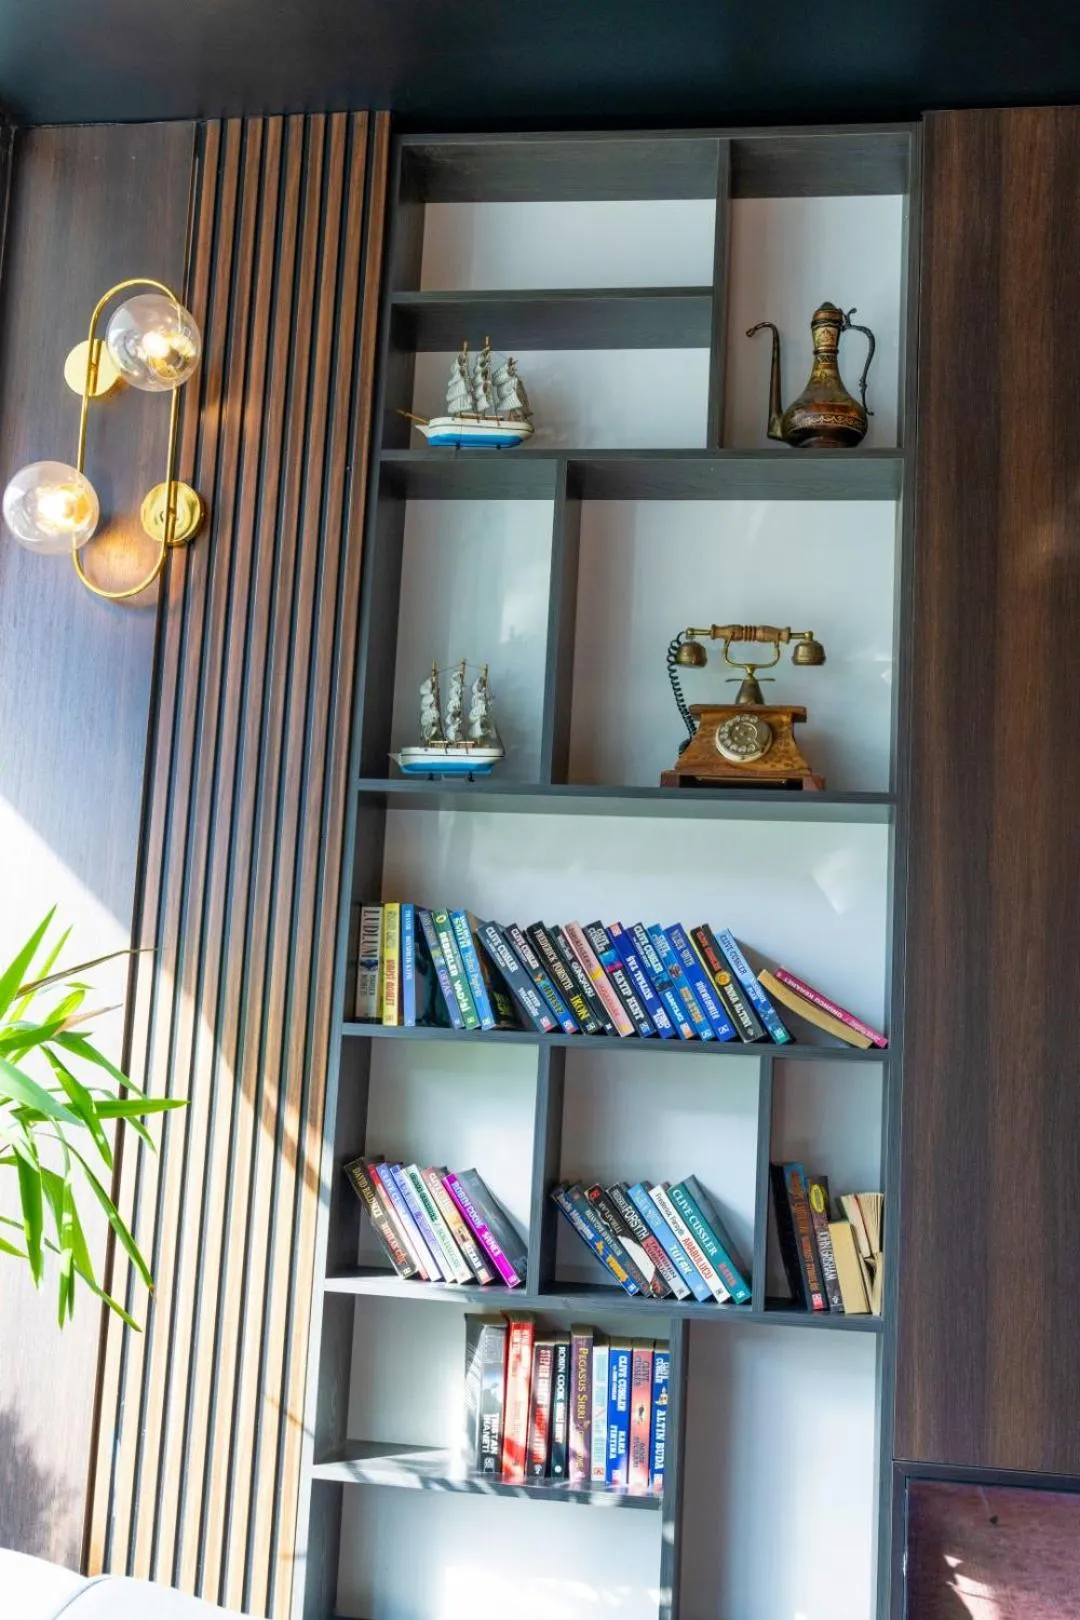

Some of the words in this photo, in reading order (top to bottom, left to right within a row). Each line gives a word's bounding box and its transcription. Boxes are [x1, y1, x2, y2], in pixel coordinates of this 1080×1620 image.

[360, 909, 379, 958] LUDLUM
[484, 925, 502, 946] CLIVE
[496, 943, 519, 973] CUSSLER
[510, 927, 525, 946] CLIVE
[519, 943, 539, 969] CUSSLER
[586, 926, 606, 953] CUSSLER
[594, 927, 609, 946] CLIVE
[632, 924, 649, 946] CLIVE
[642, 943, 663, 974] CUSSLER
[438, 931, 458, 976] BEBEKLER
[533, 928, 558, 963] FREDERICK
[551, 960, 573, 991] FORSYTH
[719, 934, 733, 952] CLIVE
[728, 949, 747, 975] CUSSLER
[612, 969, 632, 997] KAYIP
[625, 995, 644, 1021] KENT
[632, 969, 653, 1000] KUTSAL
[351, 1166, 368, 1189] DAVID
[450, 1180, 471, 1207] ROBIN
[465, 1205, 484, 1229] COOK
[654, 1192, 673, 1218] Frederick
[667, 1214, 686, 1237] Forsyth
[620, 1204, 650, 1241] FORSYTH
[671, 1187, 694, 1217] CLIVE
[687, 1213, 718, 1257] CUSSLER
[817, 1230, 831, 1249] JOHN
[668, 1243, 692, 1274] TUZAK
[681, 1236, 713, 1280] ARABULUCU
[821, 1249, 837, 1280] GRISHAM
[538, 1349, 550, 1377] STEPHEN
[557, 1346, 566, 1372] ROBIN
[578, 1347, 588, 1391] PEGASUS
[618, 1355, 627, 1377] CLIVE
[641, 1361, 649, 1382] CLIVE
[556, 1374, 565, 1400] COOK
[616, 1378, 626, 1411] CUSSLER
[577, 1394, 587, 1418] SIRRI
[490, 1413, 499, 1454] TRISTAN
[655, 1409, 665, 1440] ALTIN
[654, 1442, 664, 1469] BUDA
